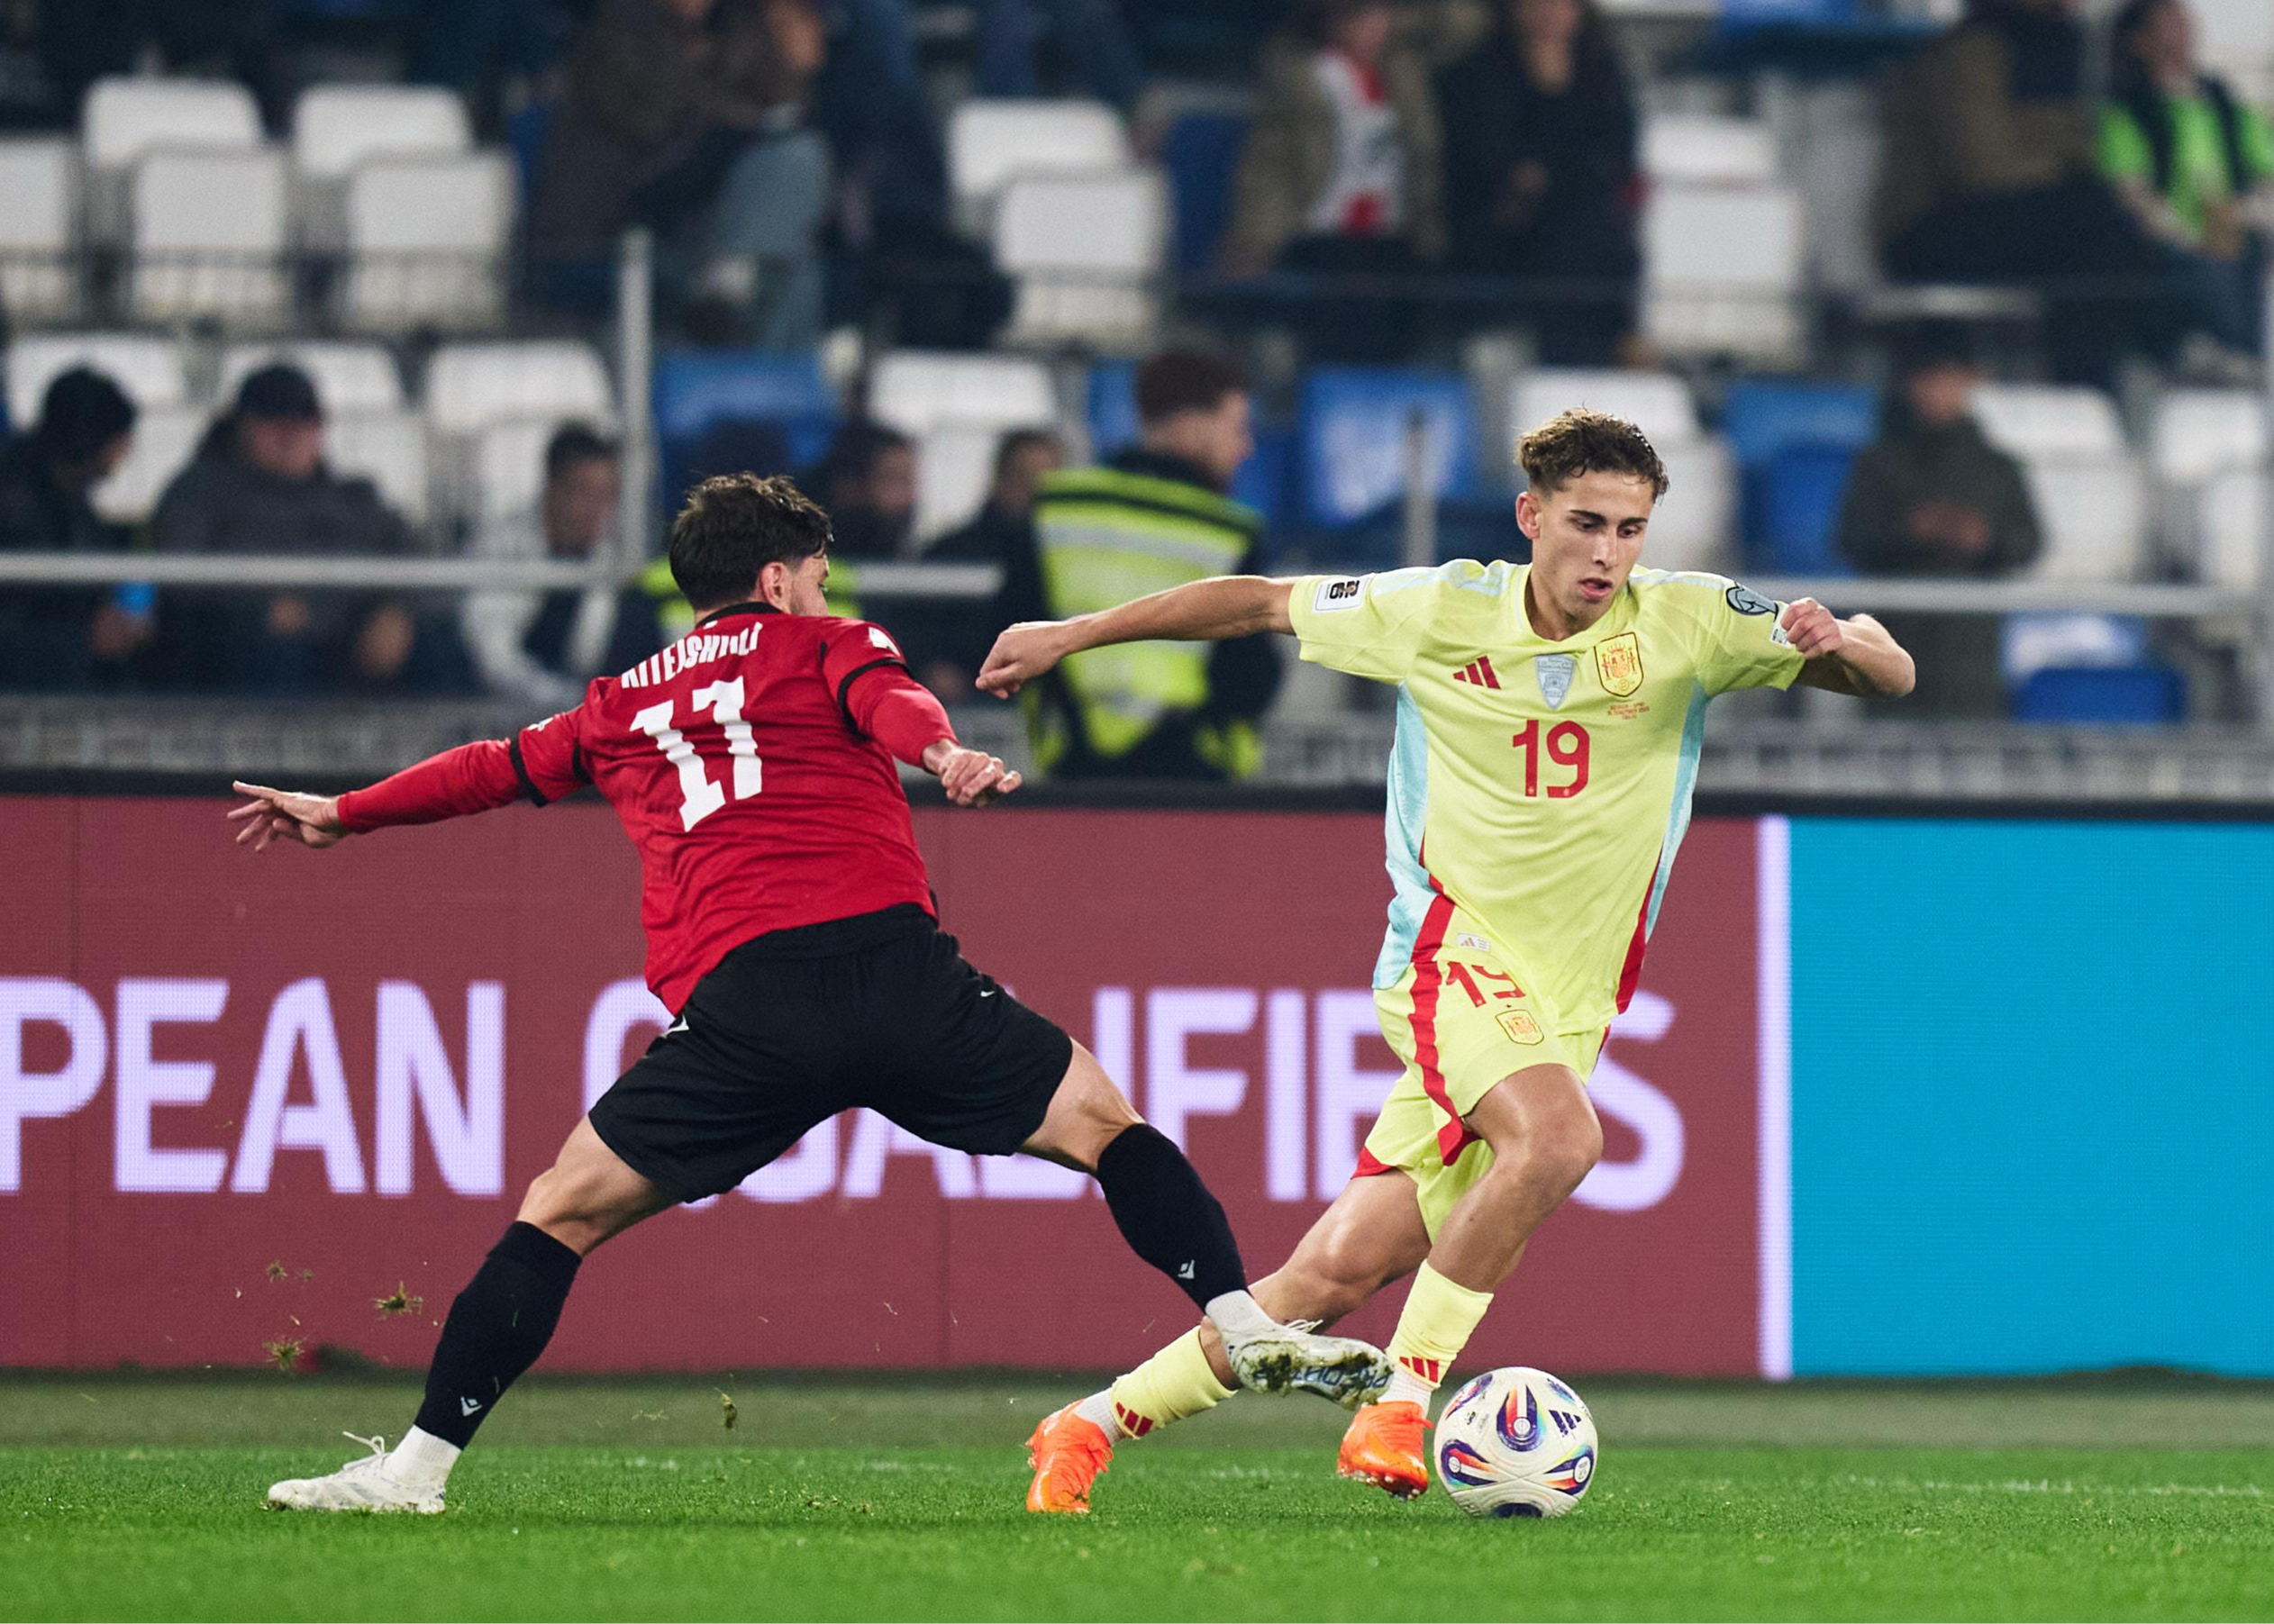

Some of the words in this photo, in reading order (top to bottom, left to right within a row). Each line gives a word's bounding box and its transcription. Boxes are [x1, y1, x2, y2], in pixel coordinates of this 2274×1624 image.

[630, 676, 763, 832] 17
[1512, 719, 1591, 799] 19
[0, 976, 507, 1197] PEAN
